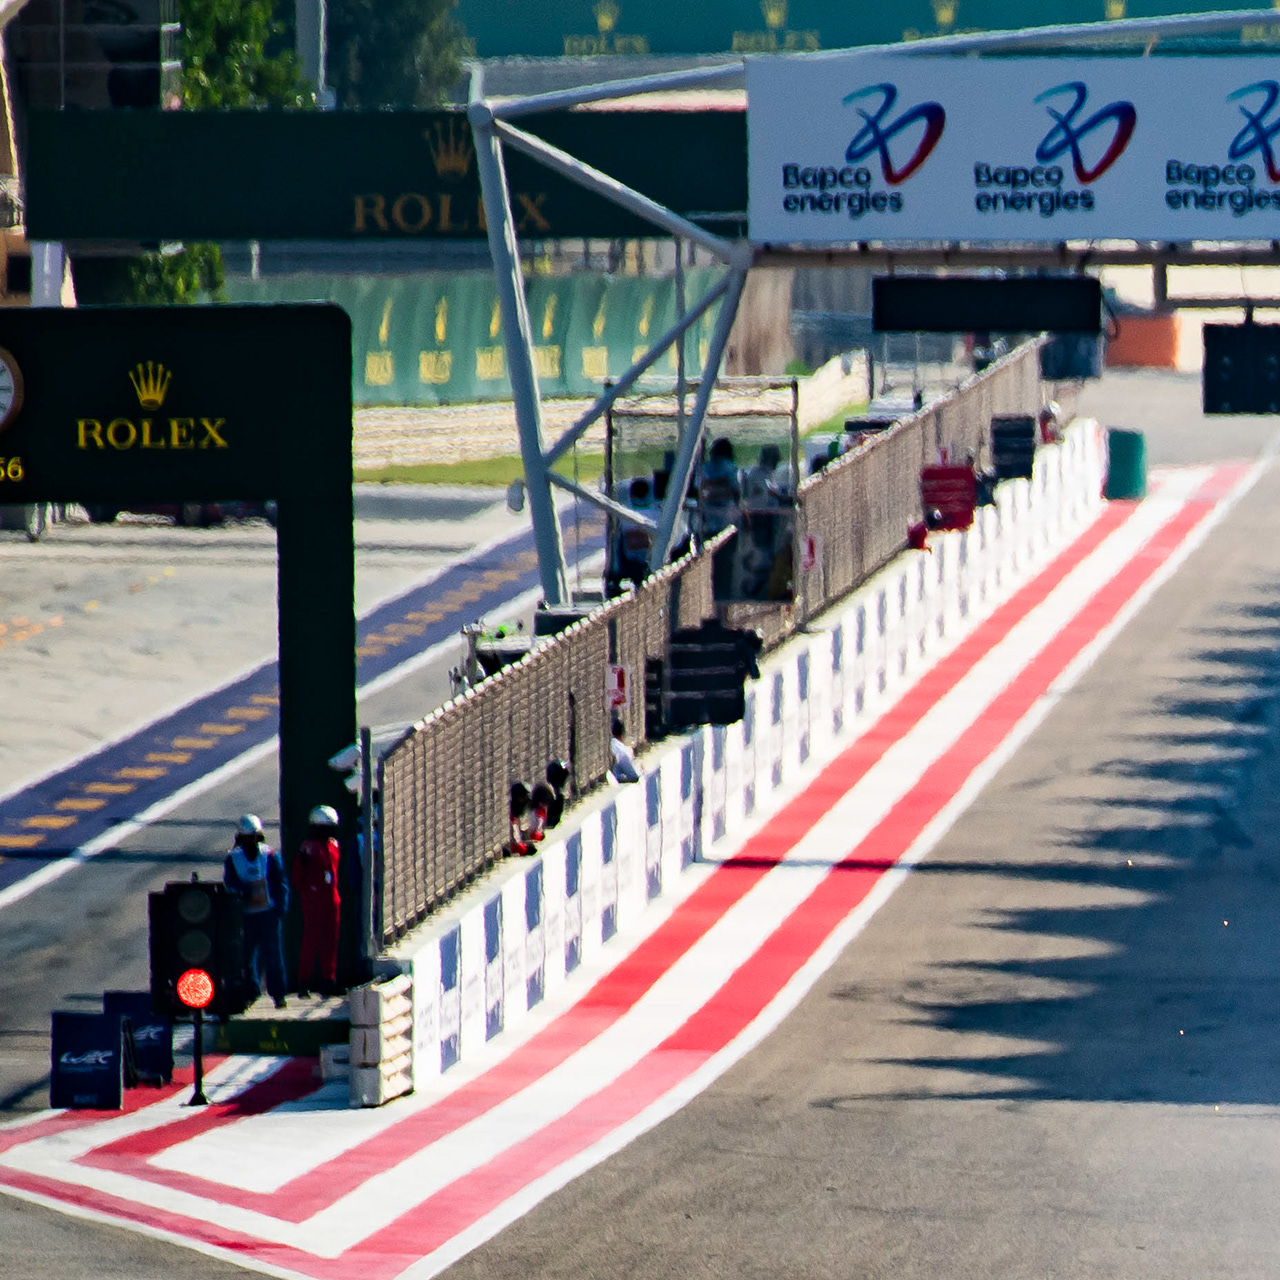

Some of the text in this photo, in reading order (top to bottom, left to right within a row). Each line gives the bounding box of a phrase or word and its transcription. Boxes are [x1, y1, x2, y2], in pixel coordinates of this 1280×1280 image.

[782, 163, 872, 192] Bapco
[974, 162, 1064, 190] Bapco
[1165, 160, 1256, 190] Bapco
[353, 193, 550, 233] ROLX
[782, 188, 903, 219] energies
[974, 186, 1096, 217] energies
[76, 418, 229, 449] ROLEX
